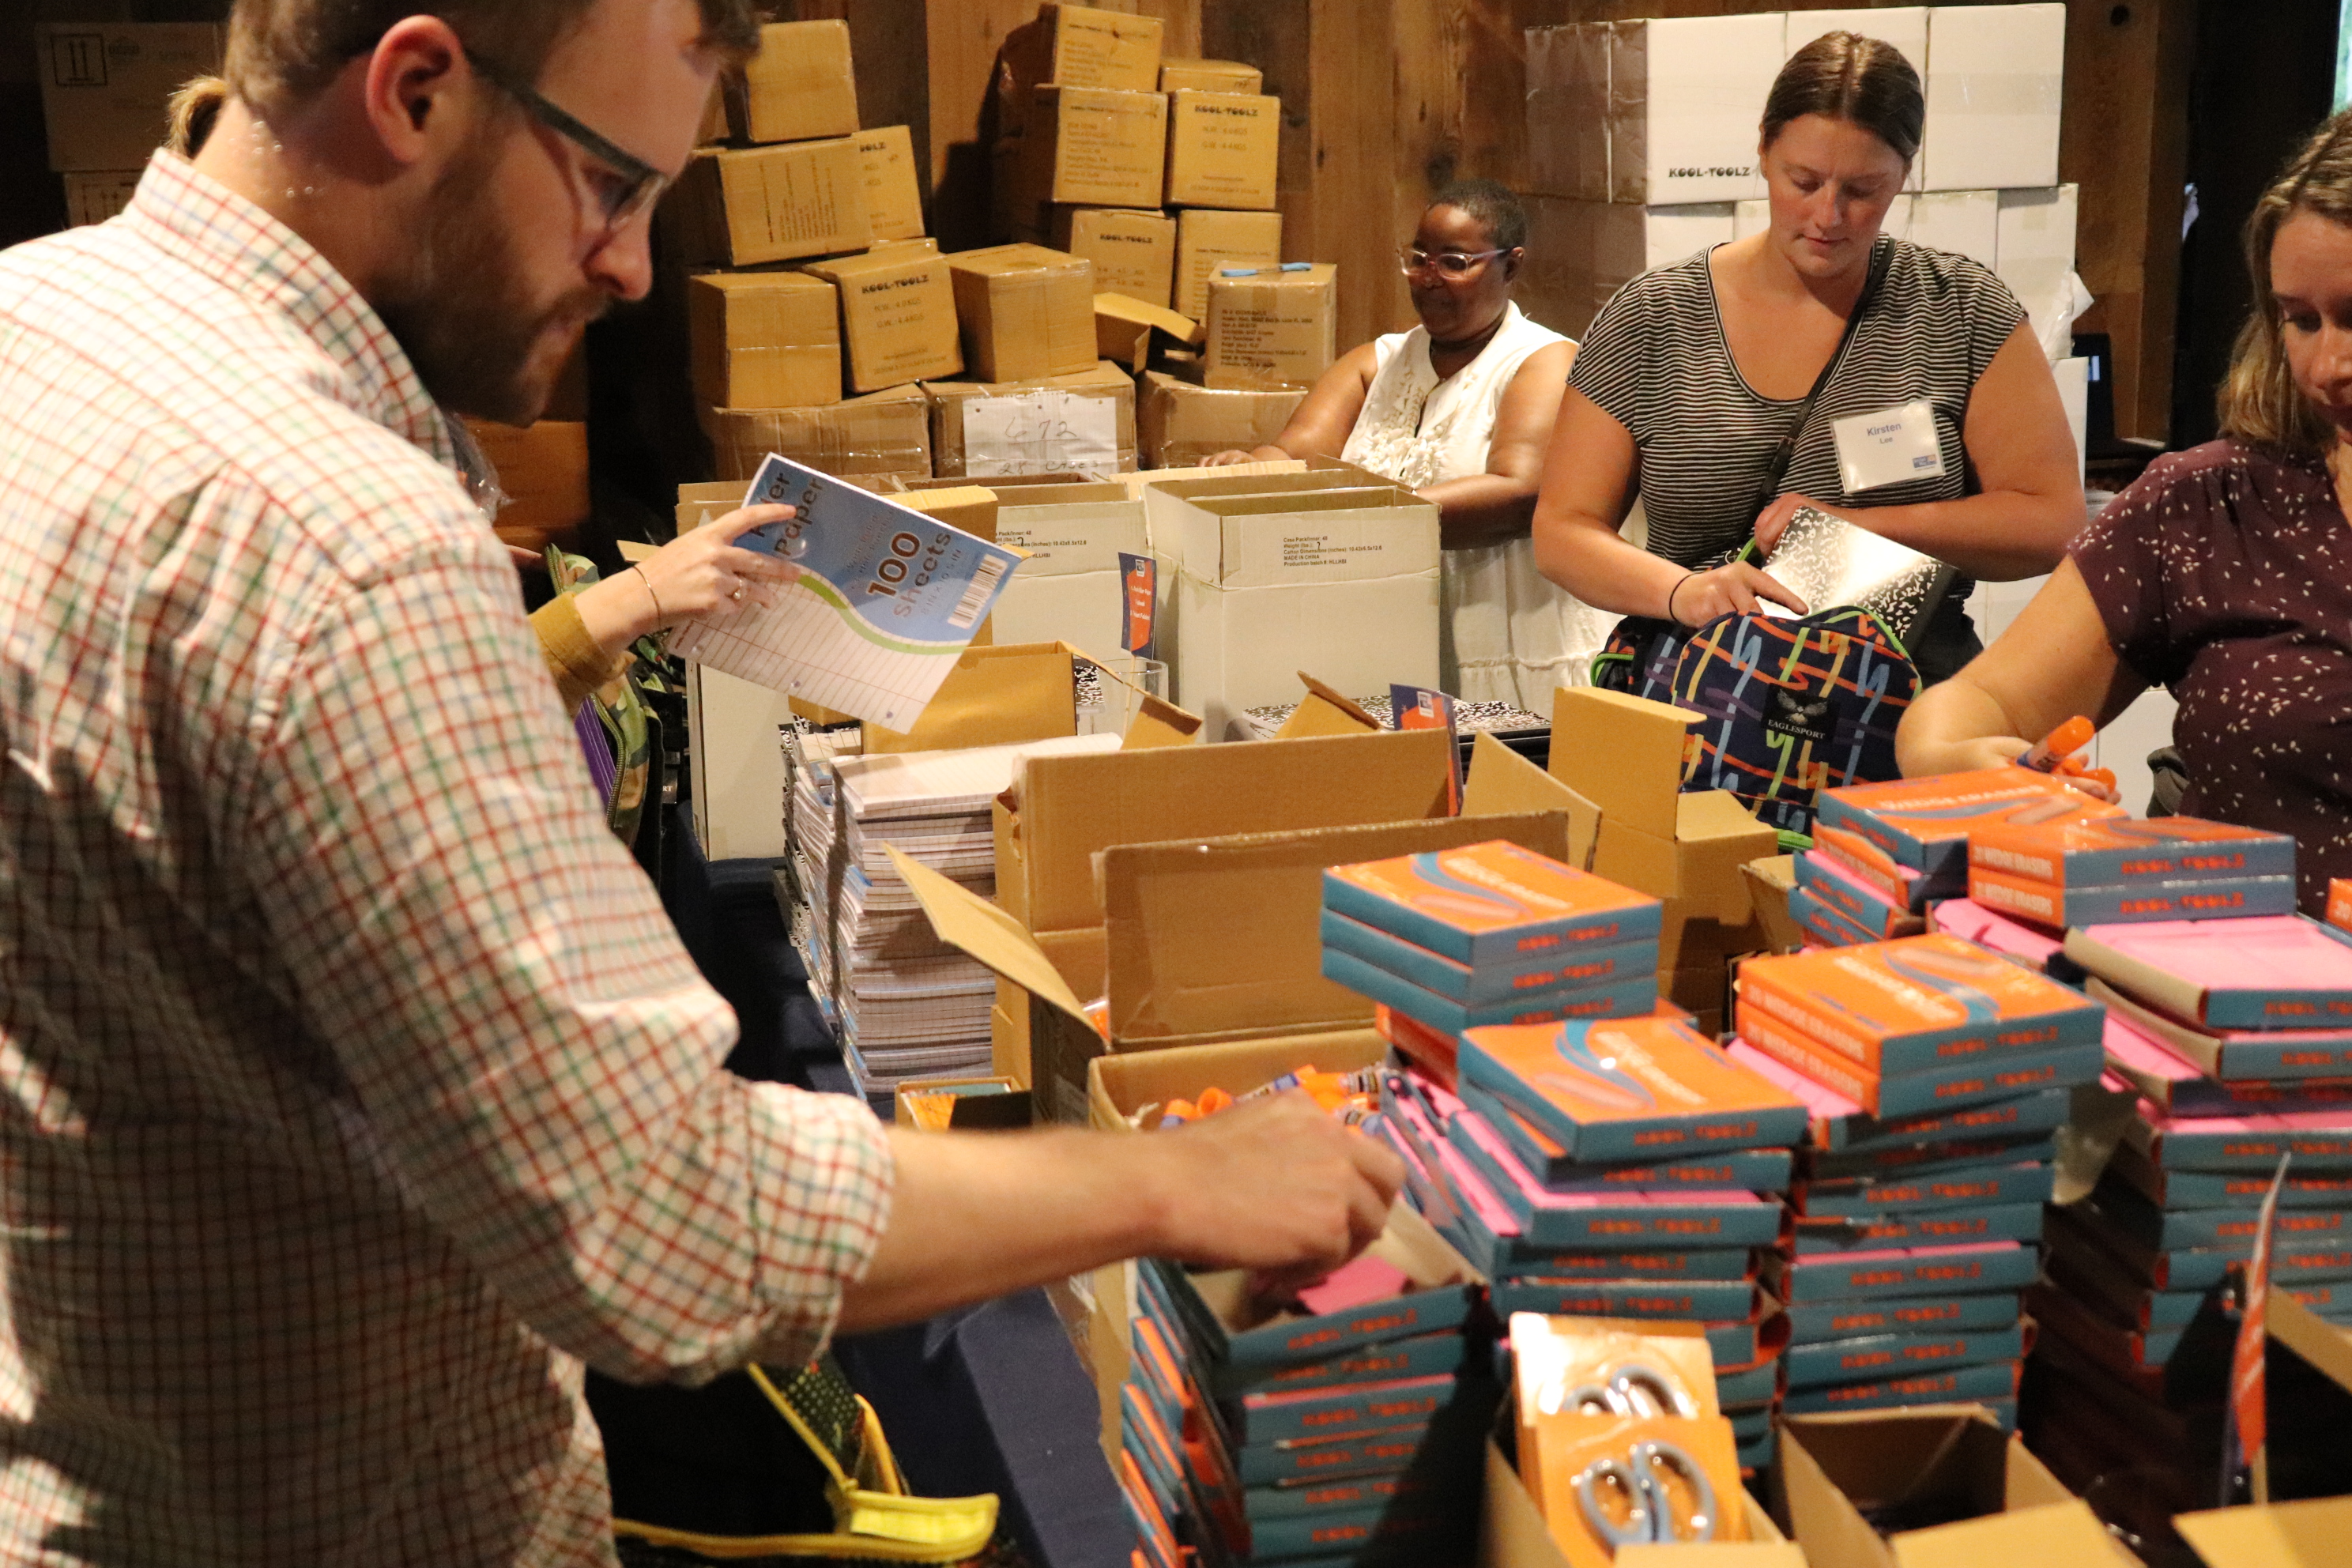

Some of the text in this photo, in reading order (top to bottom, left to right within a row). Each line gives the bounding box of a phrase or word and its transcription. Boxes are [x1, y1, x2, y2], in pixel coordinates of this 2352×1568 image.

[1194, 104, 1258, 116] KOOL-TOOLZ
[1668, 167, 1751, 178] KOOL-TOOLZ
[1099, 232, 1152, 243] KOOL-TOOLZ
[861, 274, 929, 294] KOOL-TOOLZ
[1867, 423, 1902, 436] Kirsten
[773, 477, 824, 556] Paper
[867, 530, 922, 599] 100
[892, 533, 952, 618] Sheets
[1767, 718, 1826, 740] EAGLESPORT
